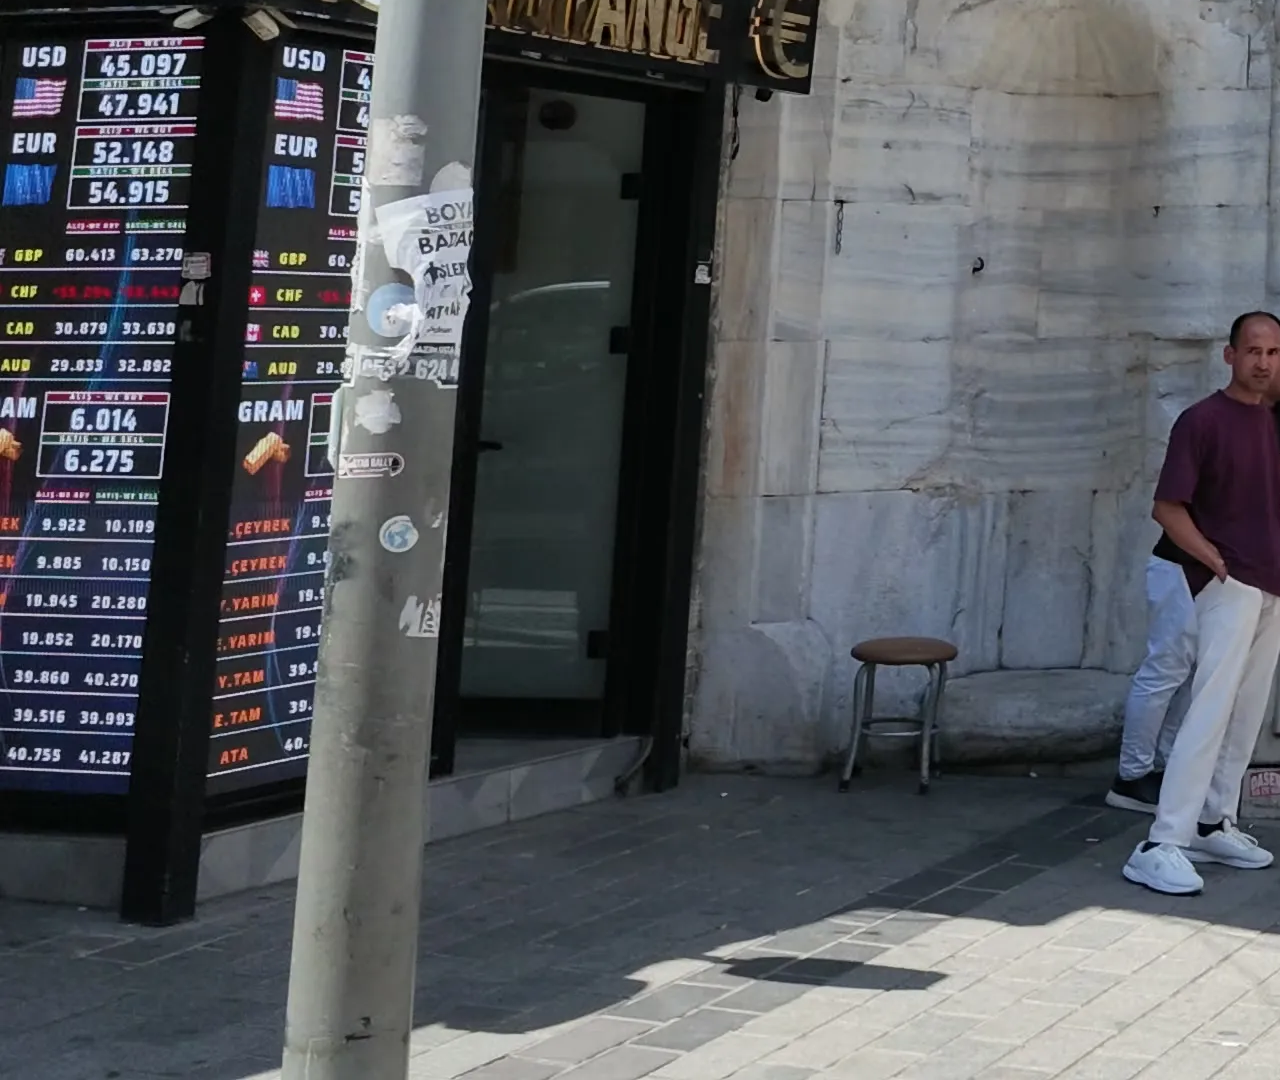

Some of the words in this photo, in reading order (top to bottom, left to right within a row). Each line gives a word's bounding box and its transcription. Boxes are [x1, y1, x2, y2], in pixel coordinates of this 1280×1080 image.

[22, 46, 67, 67] USD
[100, 53, 187, 77] 45.097
[282, 46, 327, 72] USD
[98, 92, 180, 116] 47.941
[12, 132, 57, 154] EUR
[92, 140, 174, 164] 52.148
[274, 133, 319, 158] EUR
[88, 180, 170, 204] 54.915
[14, 249, 43, 262] GBP
[65, 248, 116, 262] 60.413
[130, 248, 183, 262] 63.270
[279, 252, 307, 266] GBP
[10, 285, 38, 299] CHF
[276, 289, 304, 302] CHF
[6, 322, 34, 336] CAD
[55, 322, 108, 336] 30.879
[272, 325, 300, 339] CAD
[0, 358, 31, 372] AUD
[118, 359, 172, 373] 32.892
[267, 362, 297, 376] AUD
[238, 399, 304, 423] GRAM
[70, 408, 137, 432] 6.014
[64, 449, 134, 473] 6.275
[42, 518, 86, 532] 9.922
[102, 557, 150, 572] 10.150
[91, 595, 147, 610] 20.280
[90, 634, 143, 649] 20.170
[13, 669, 70, 685] 39.860
[83, 672, 139, 688] 40.270
[218, 669, 265, 689] Y.TAM
[13, 708, 66, 723] 39.516
[214, 707, 262, 728] E.TAM
[7, 746, 62, 762] 40.755
[220, 747, 249, 766] ATA
